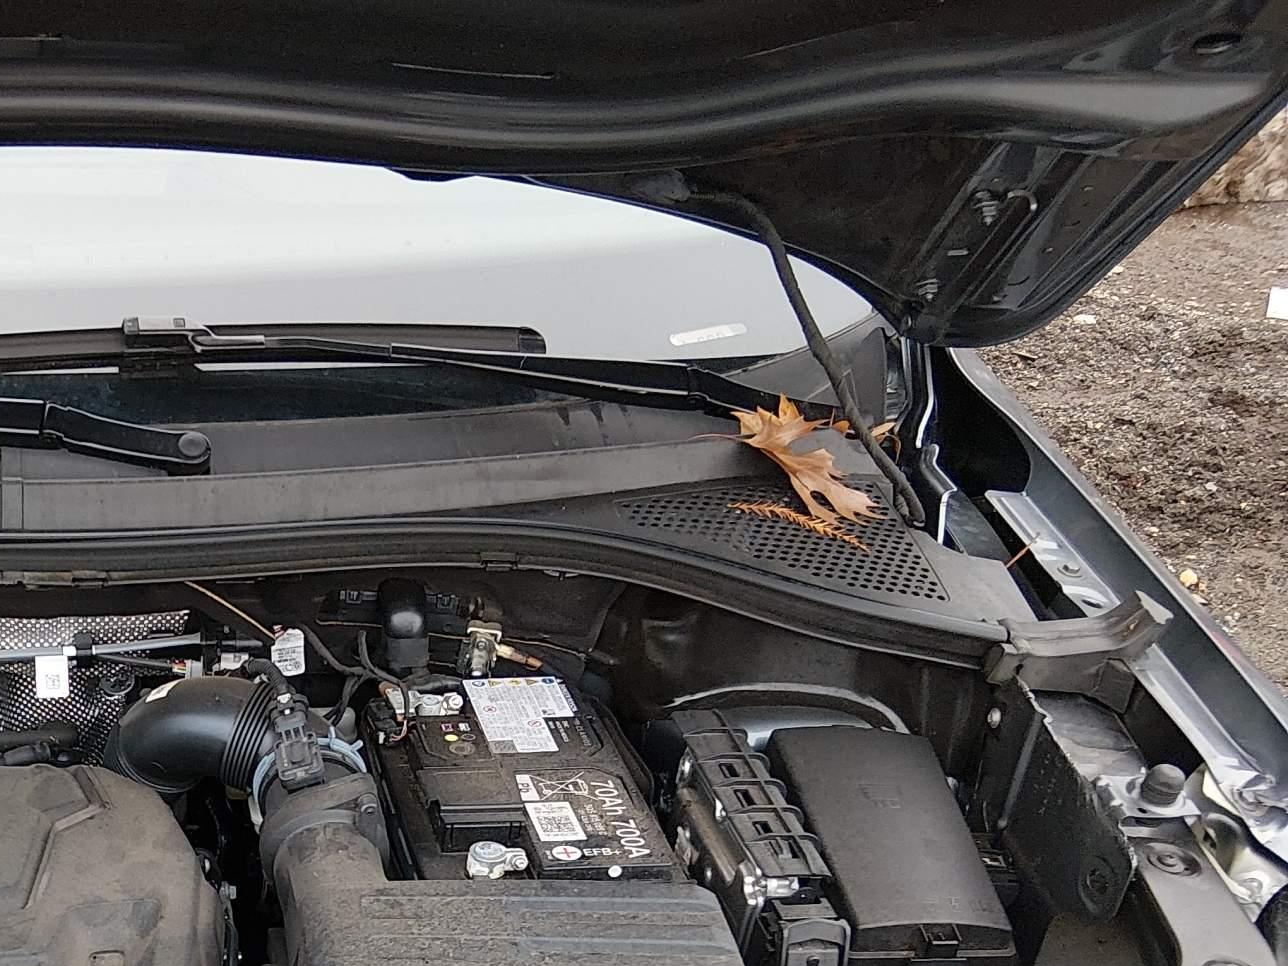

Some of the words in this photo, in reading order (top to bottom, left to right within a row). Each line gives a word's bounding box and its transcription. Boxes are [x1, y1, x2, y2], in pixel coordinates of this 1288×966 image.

[518, 782, 530, 794] Pb
[590, 779, 627, 816] 70Ah
[611, 819, 651, 859] 700A
[582, 847, 623, 857] EFB+
